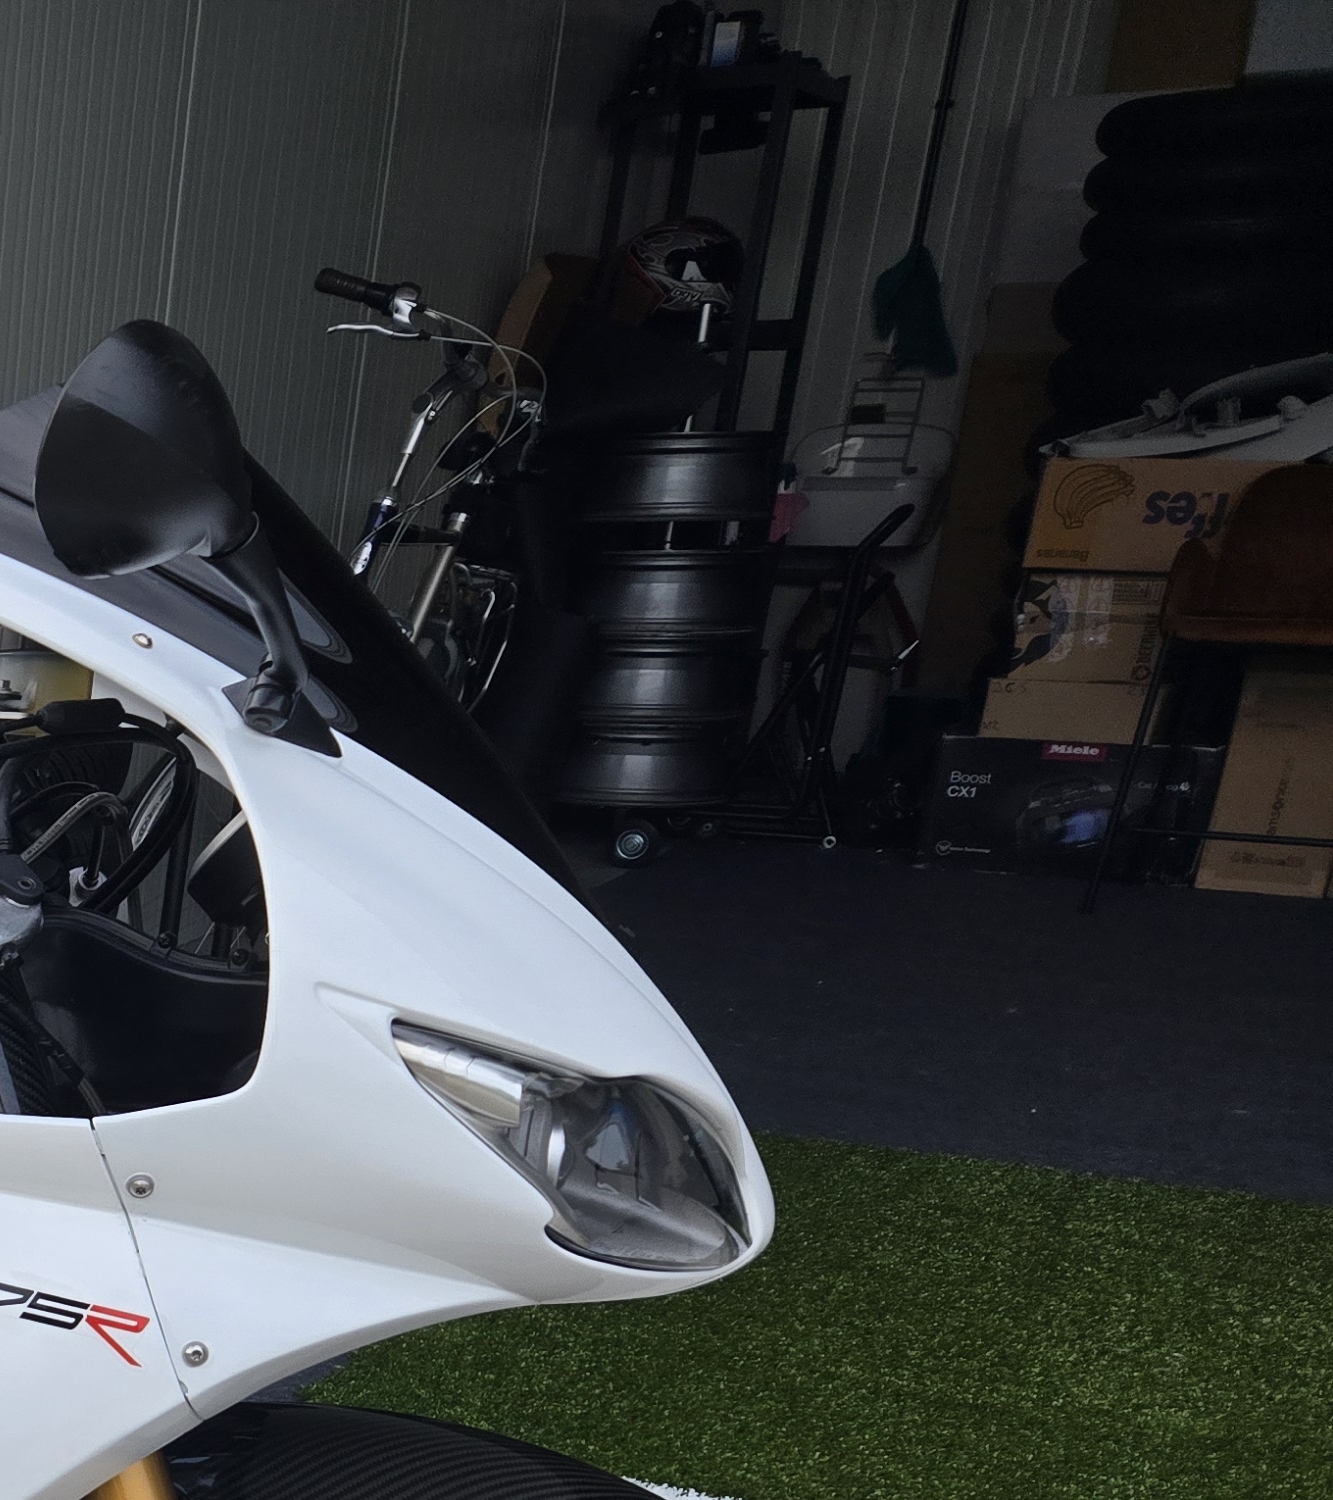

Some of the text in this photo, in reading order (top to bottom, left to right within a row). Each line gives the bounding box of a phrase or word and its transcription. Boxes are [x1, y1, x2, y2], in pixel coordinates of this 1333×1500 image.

[1048, 743, 1100, 756] Miele
[950, 769, 993, 785] Boost
[946, 785, 978, 799] CX1
